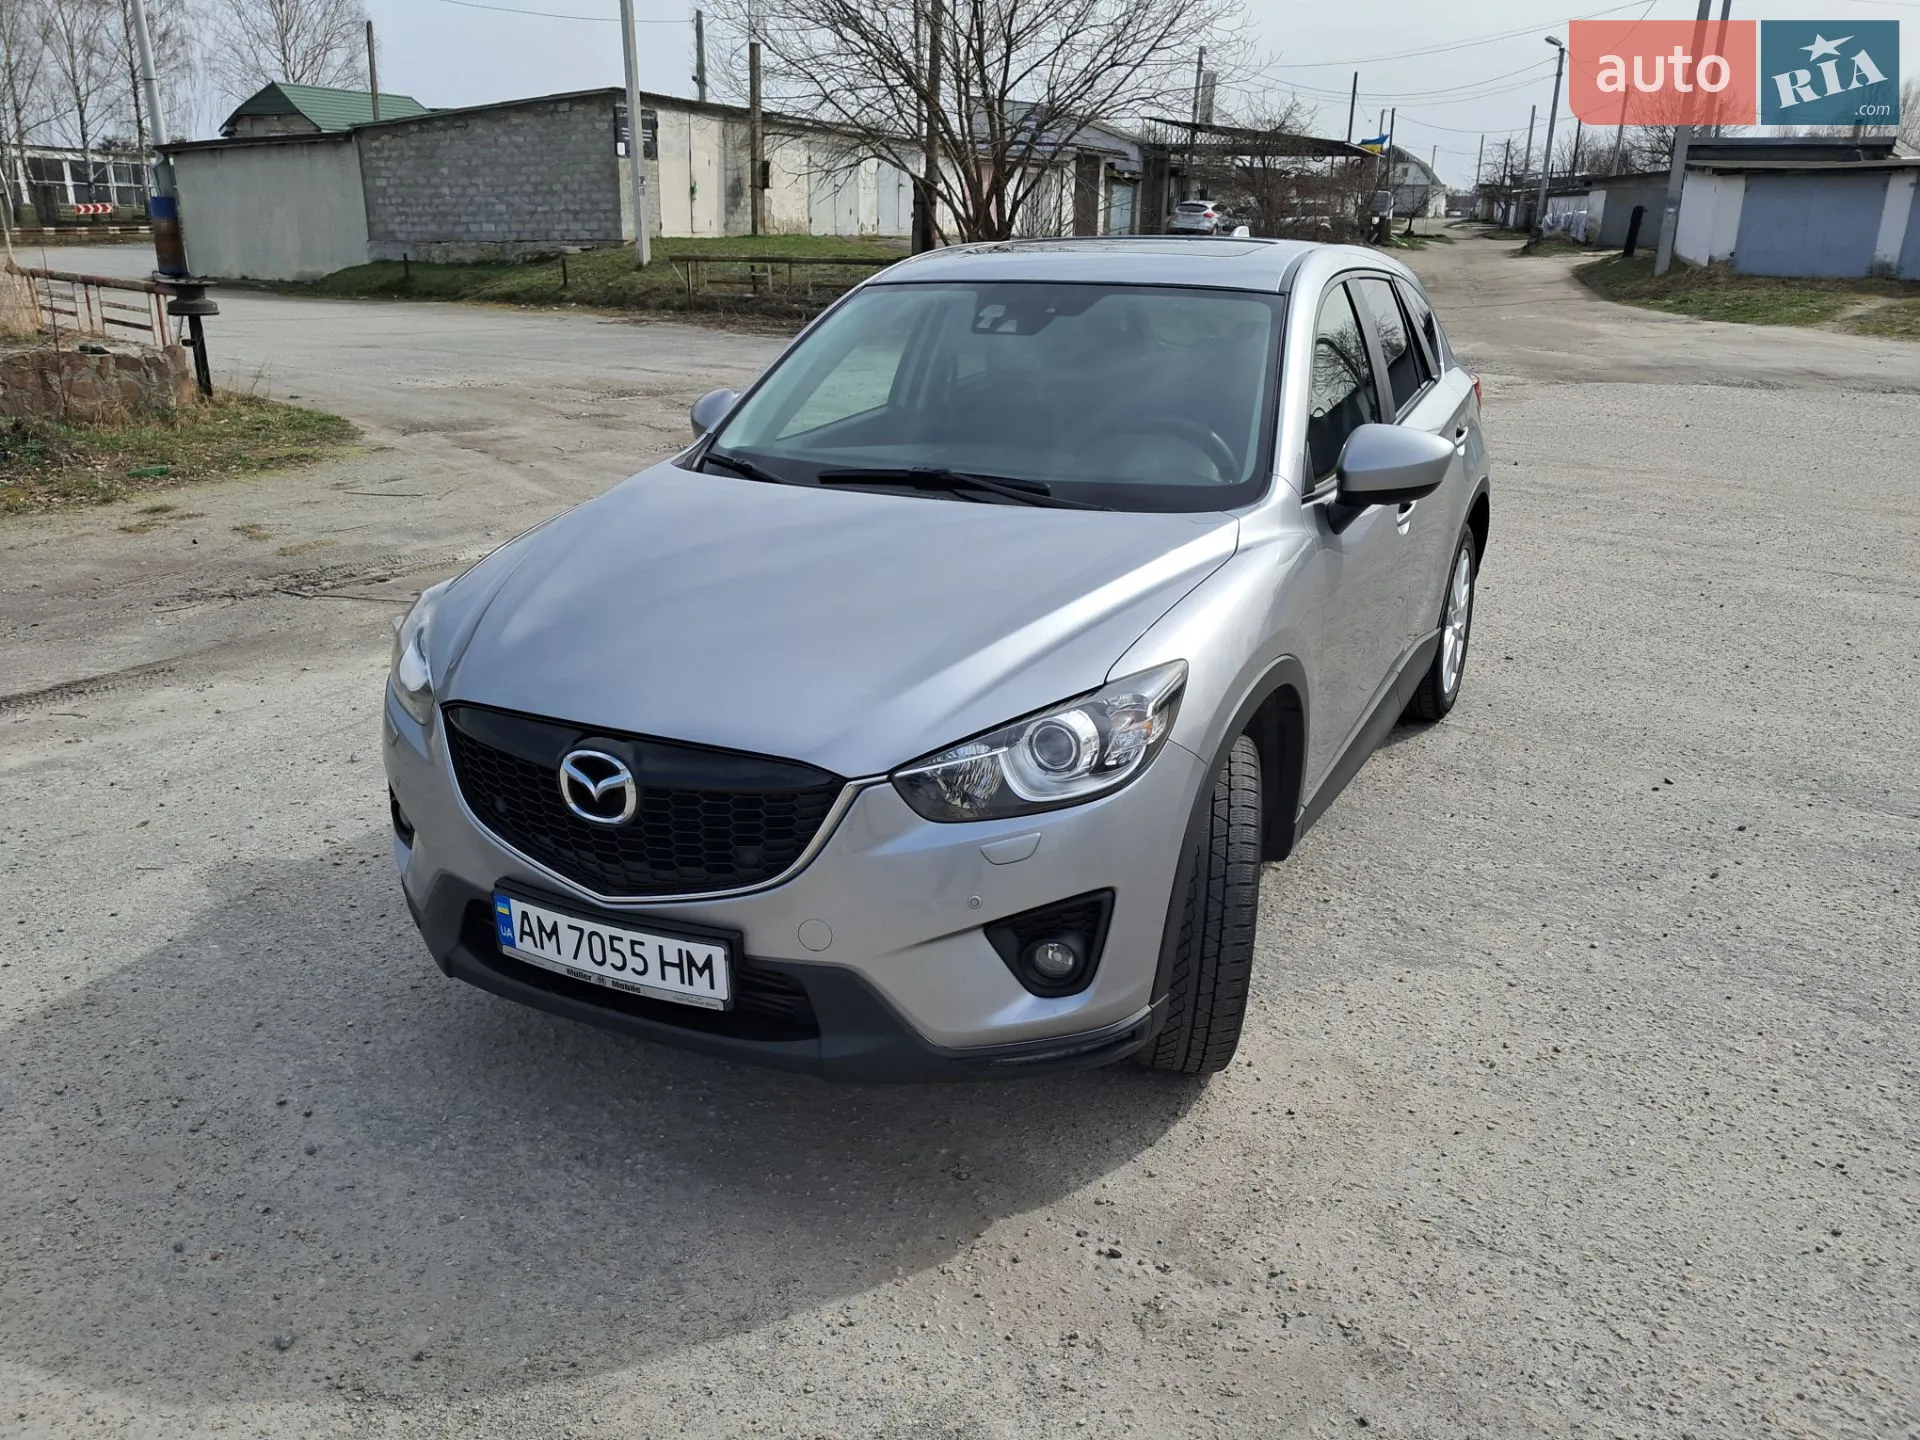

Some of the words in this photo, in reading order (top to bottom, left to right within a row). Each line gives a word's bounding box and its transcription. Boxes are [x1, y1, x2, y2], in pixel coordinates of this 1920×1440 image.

[500, 924, 513, 939] UA
[519, 909, 562, 956] AM
[567, 924, 649, 977] 7055
[658, 944, 716, 990] HM
